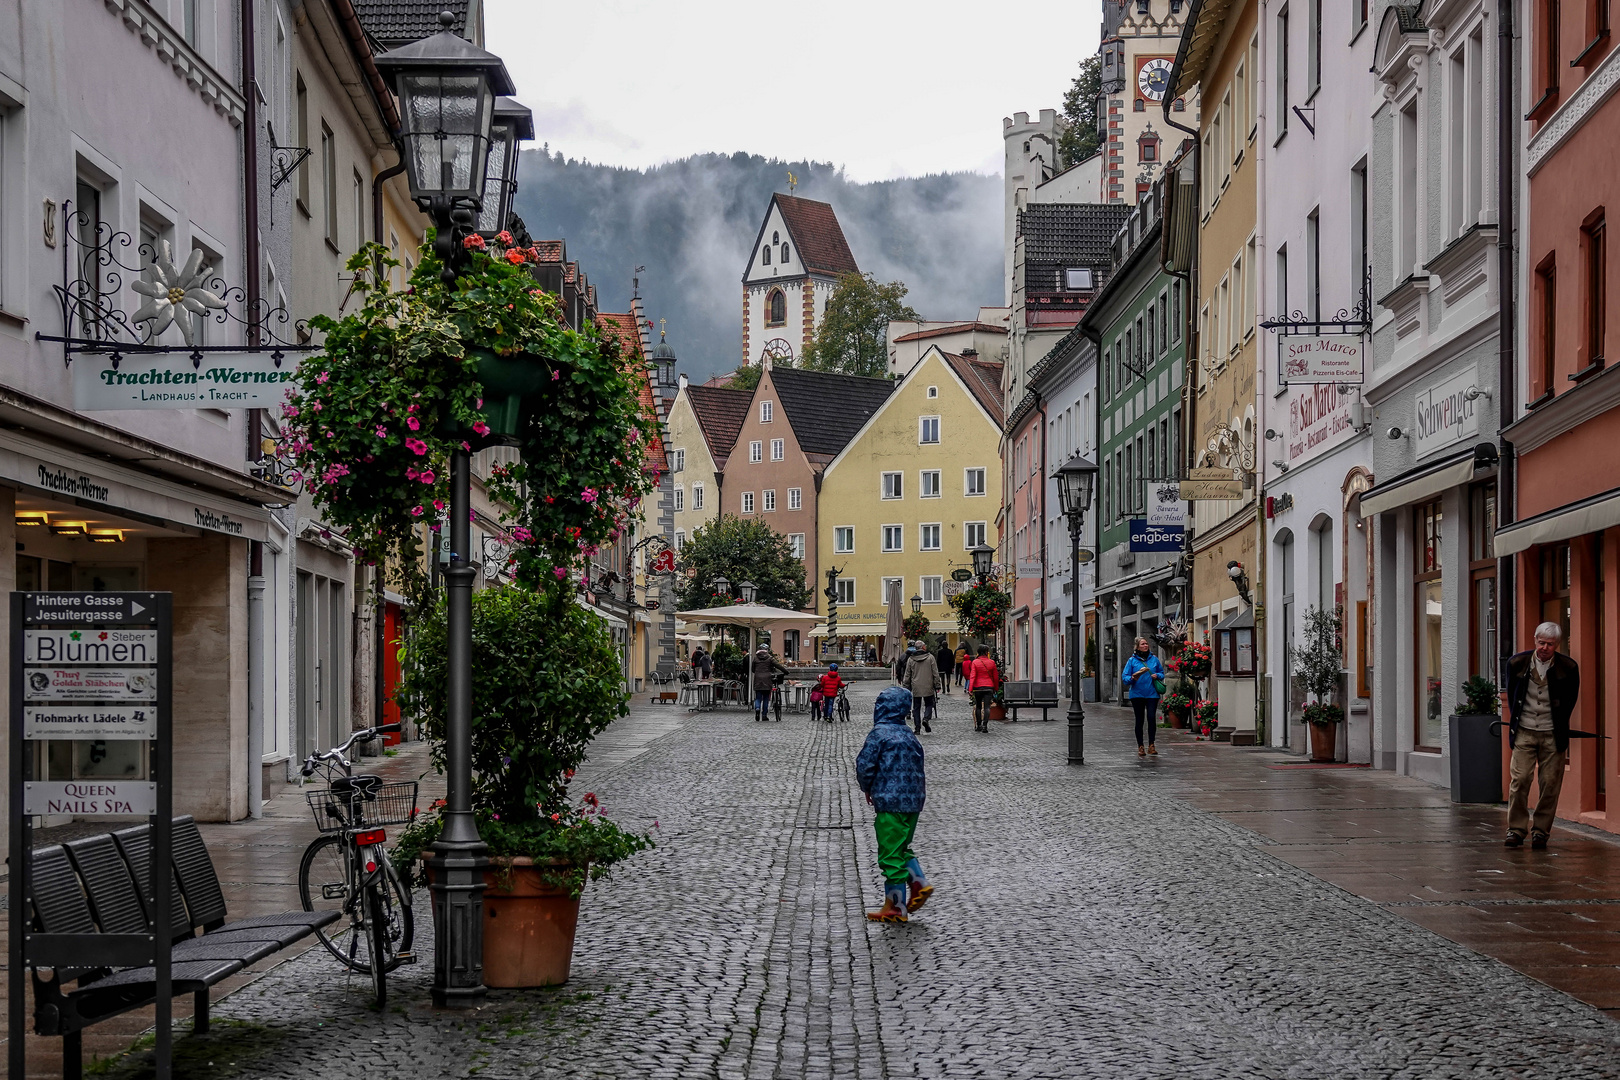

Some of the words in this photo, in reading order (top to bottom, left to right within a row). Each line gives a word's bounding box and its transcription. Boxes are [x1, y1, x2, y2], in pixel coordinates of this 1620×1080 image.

[1288, 343, 1312, 358] San
[1316, 340, 1357, 356] Marco
[100, 368, 291, 385] Trachten-Werner
[141, 389, 196, 401] LANDHAUS
[209, 388, 248, 400] TRACHT
[1300, 394, 1312, 432] San
[1314, 380, 1337, 422] Marco
[1308, 422, 1328, 449] Restaurant
[1193, 470, 1229, 479] Ludwigs
[38, 464, 108, 501] Trachten-Werner
[1195, 482, 1229, 490] Hotel
[1183, 490, 1242, 498] Restaurant
[1150, 514, 1162, 524] City
[1164, 512, 1186, 521] Hostel
[1132, 532, 1182, 544] engbers
[36, 595, 80, 605] Hintere
[84, 595, 123, 606] Gasse
[36, 610, 123, 622] Jesuitergasse
[111, 632, 145, 641] Steber
[37, 637, 145, 661] Blumen
[35, 714, 89, 723] Flohmarkt
[93, 714, 126, 723] Lädele
[64, 783, 116, 798] QUEEN
[48, 800, 98, 813] NAILS
[104, 799, 133, 813] SPA
